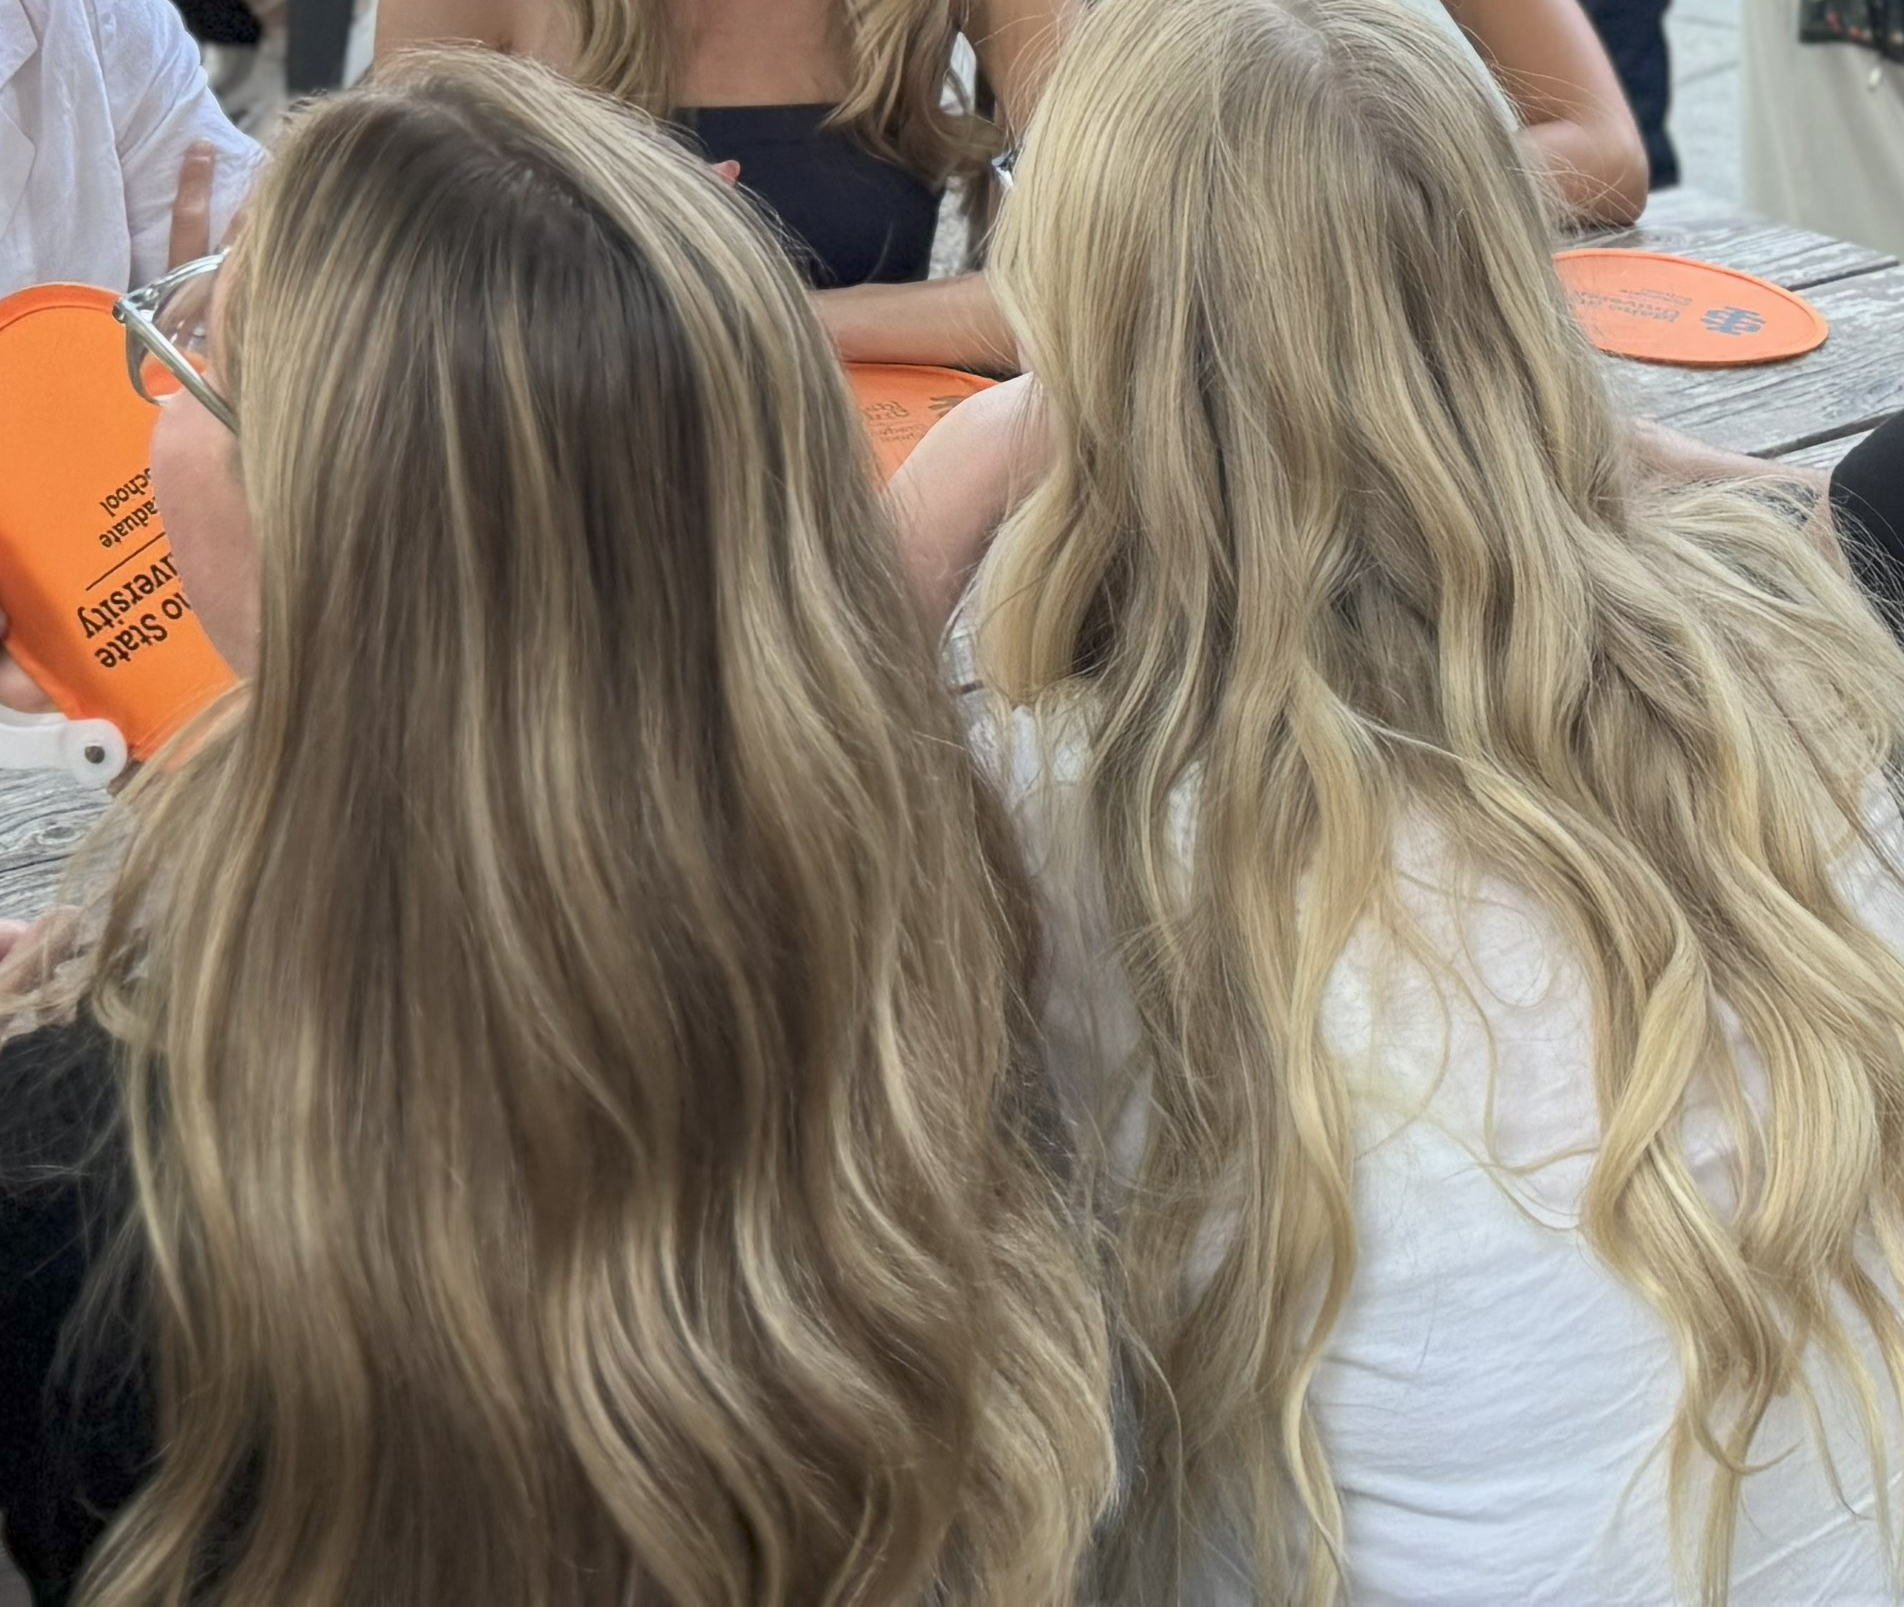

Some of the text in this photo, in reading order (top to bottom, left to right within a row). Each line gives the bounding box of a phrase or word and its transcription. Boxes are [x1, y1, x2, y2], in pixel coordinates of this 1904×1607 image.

[99, 496, 158, 548] aduate
[77, 552, 178, 639] iversity
[94, 613, 168, 668] State
